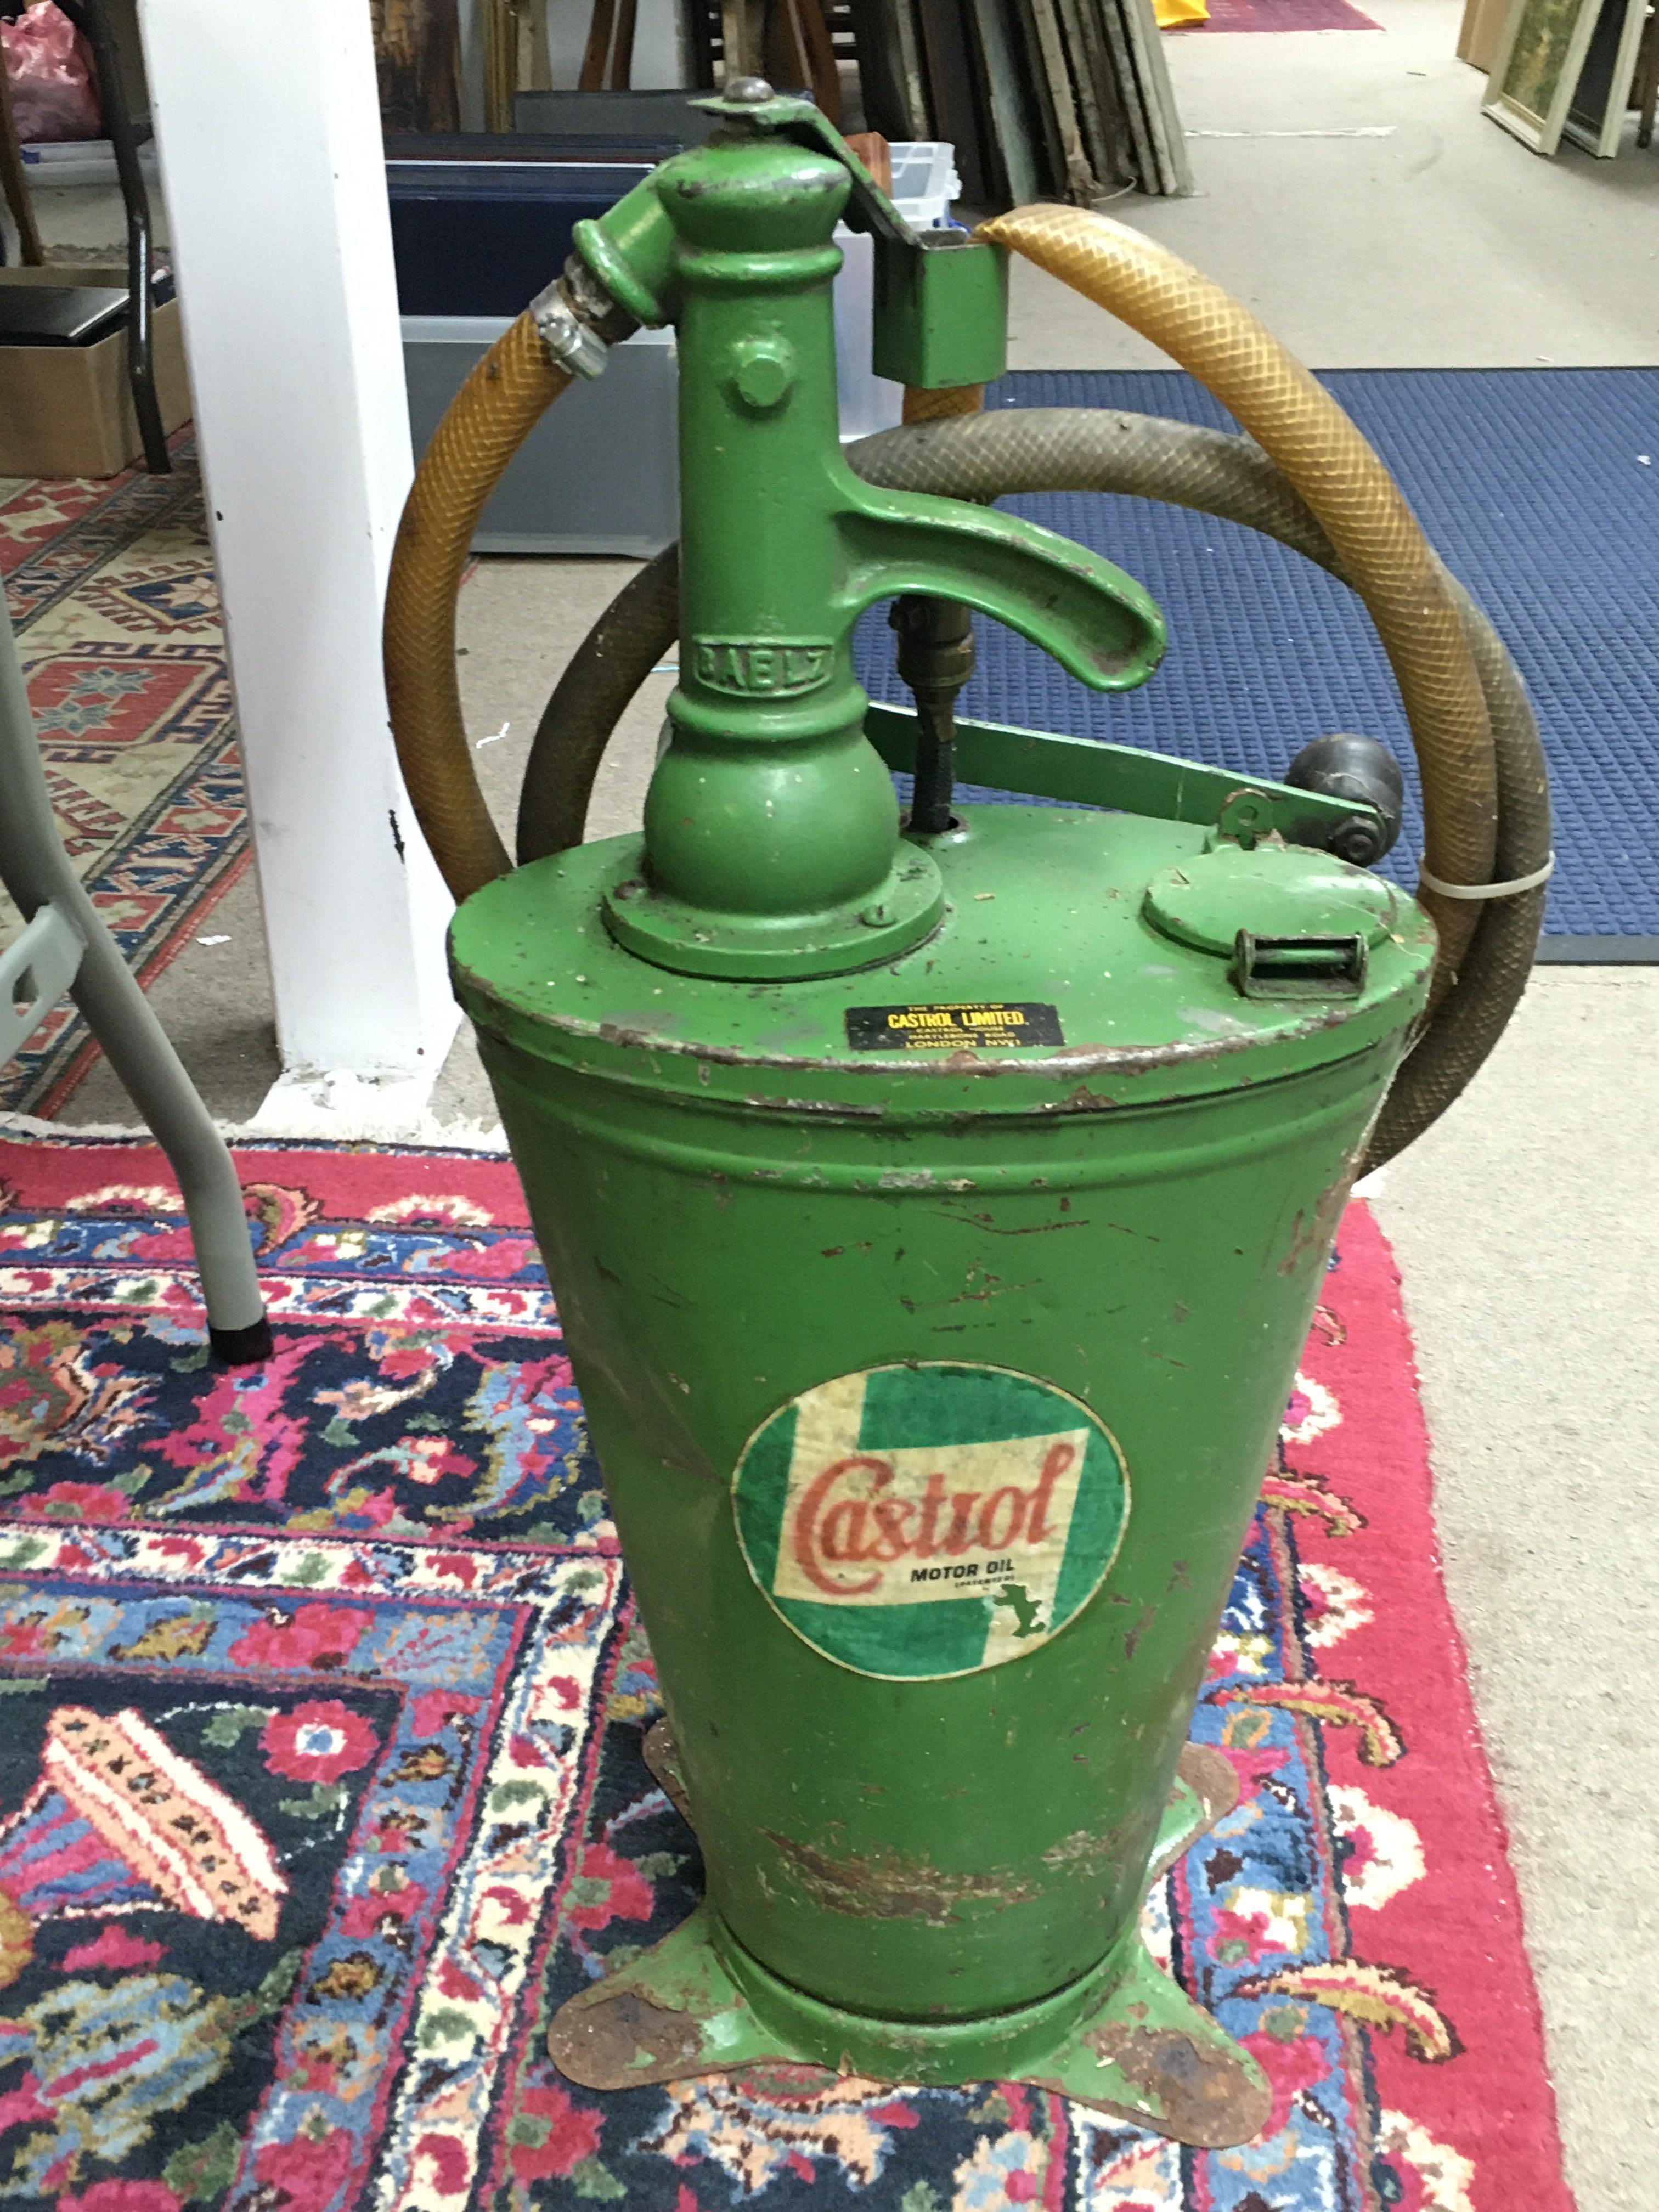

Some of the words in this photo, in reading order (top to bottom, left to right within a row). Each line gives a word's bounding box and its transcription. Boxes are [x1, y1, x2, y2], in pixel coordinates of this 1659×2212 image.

[888, 1013, 957, 1029] CASTROL
[905, 1040, 977, 1048] LONDON
[792, 1443, 1075, 1596] Castrol
[910, 1563, 979, 1582] MOTOR
[986, 1558, 1015, 1574] OIL
